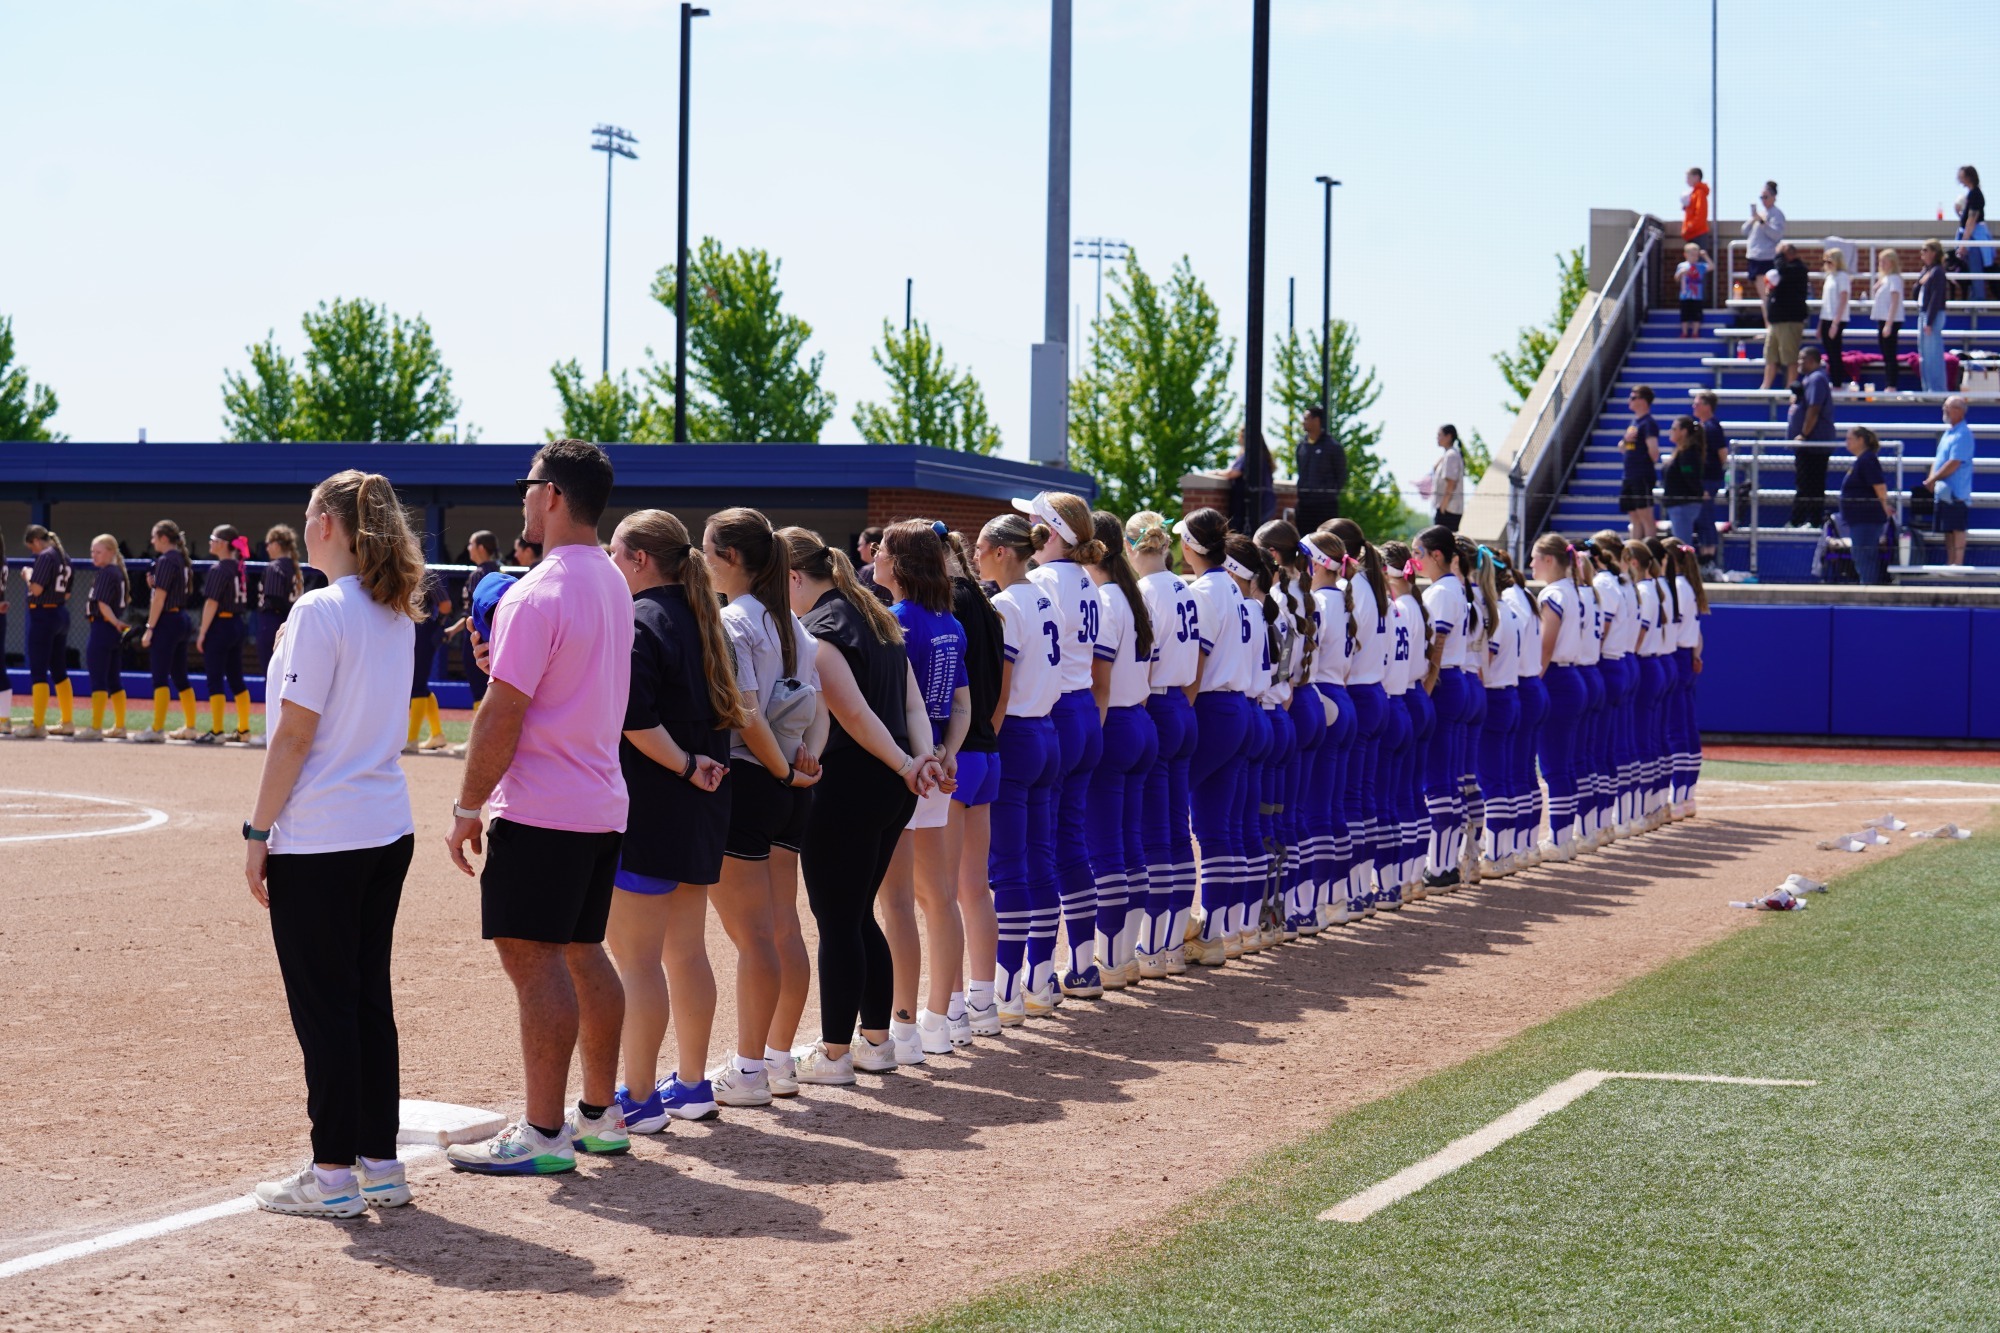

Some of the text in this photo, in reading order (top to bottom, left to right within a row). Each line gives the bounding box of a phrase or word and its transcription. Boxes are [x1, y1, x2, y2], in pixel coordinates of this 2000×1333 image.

[1042, 620, 1060, 666] 3
[1078, 600, 1099, 643] 30
[1177, 600, 1200, 643] 32
[1395, 626, 1410, 660] 26
[1072, 977, 1087, 985] UA
